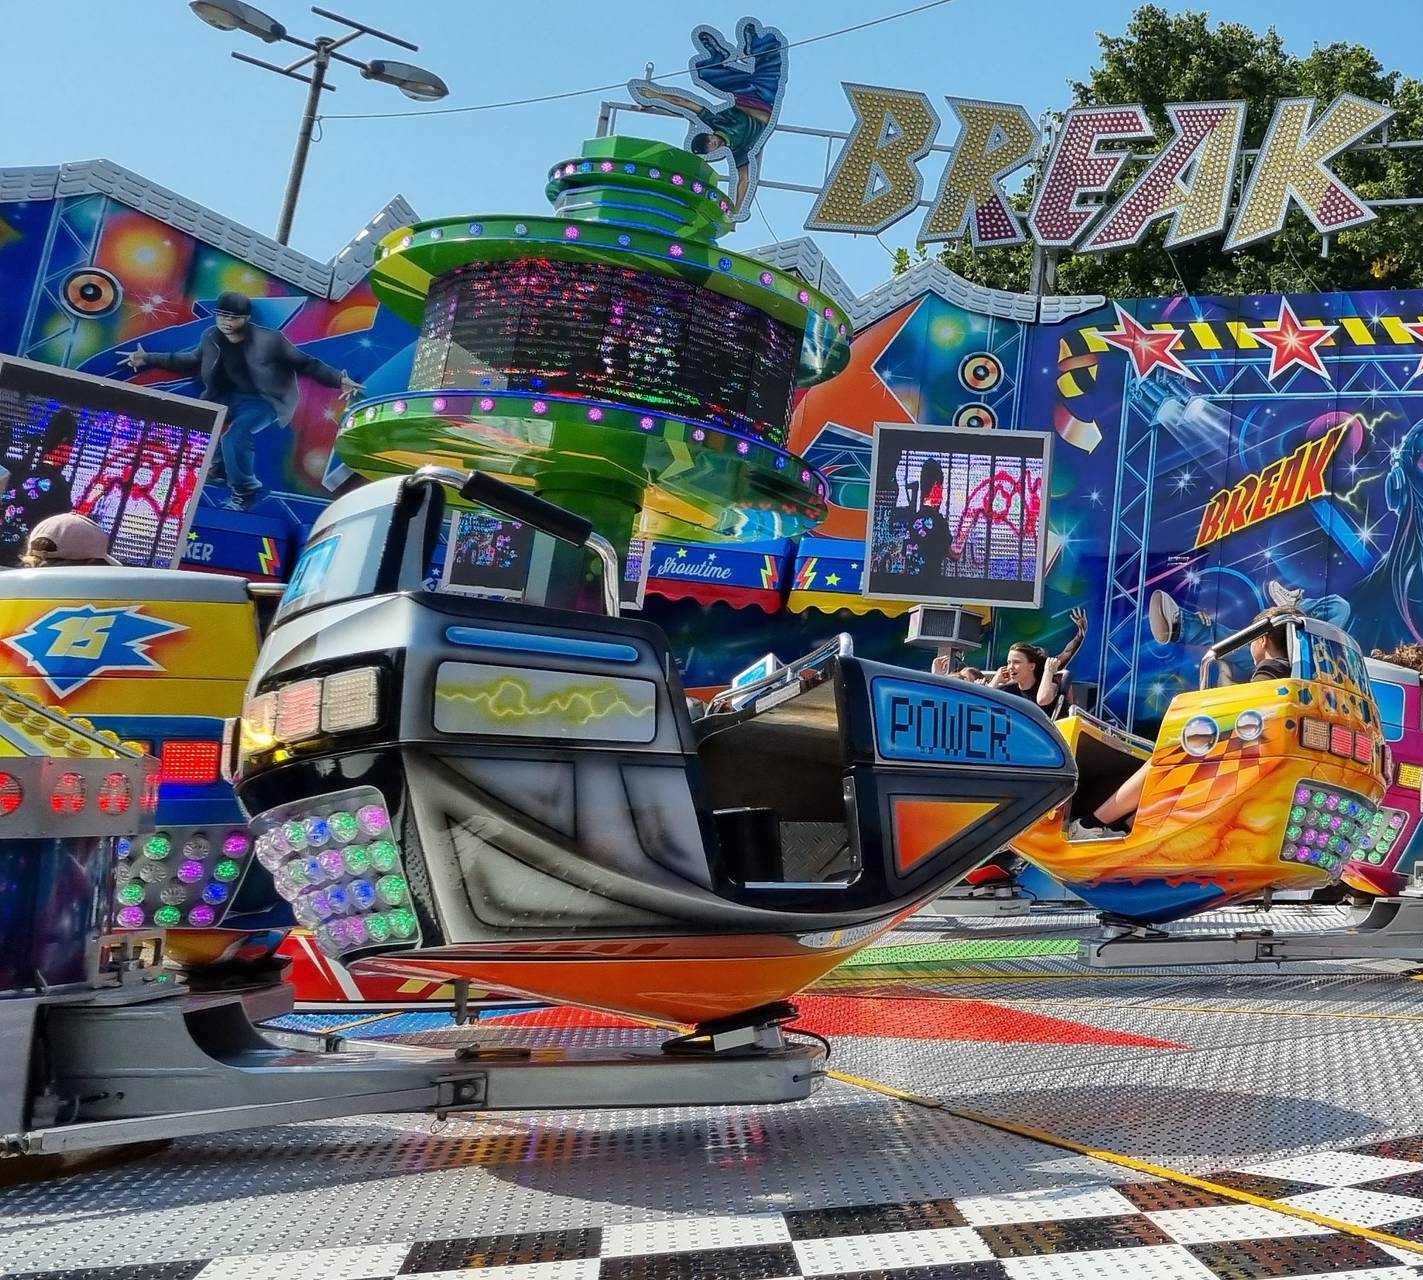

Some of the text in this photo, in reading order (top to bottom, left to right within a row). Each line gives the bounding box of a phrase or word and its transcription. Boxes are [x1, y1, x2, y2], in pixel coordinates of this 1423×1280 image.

[803, 82, 1396, 253] BREAK
[1194, 422, 1347, 550] BREAK
[657, 556, 732, 579] Showtime
[890, 696, 1011, 762] POWER
